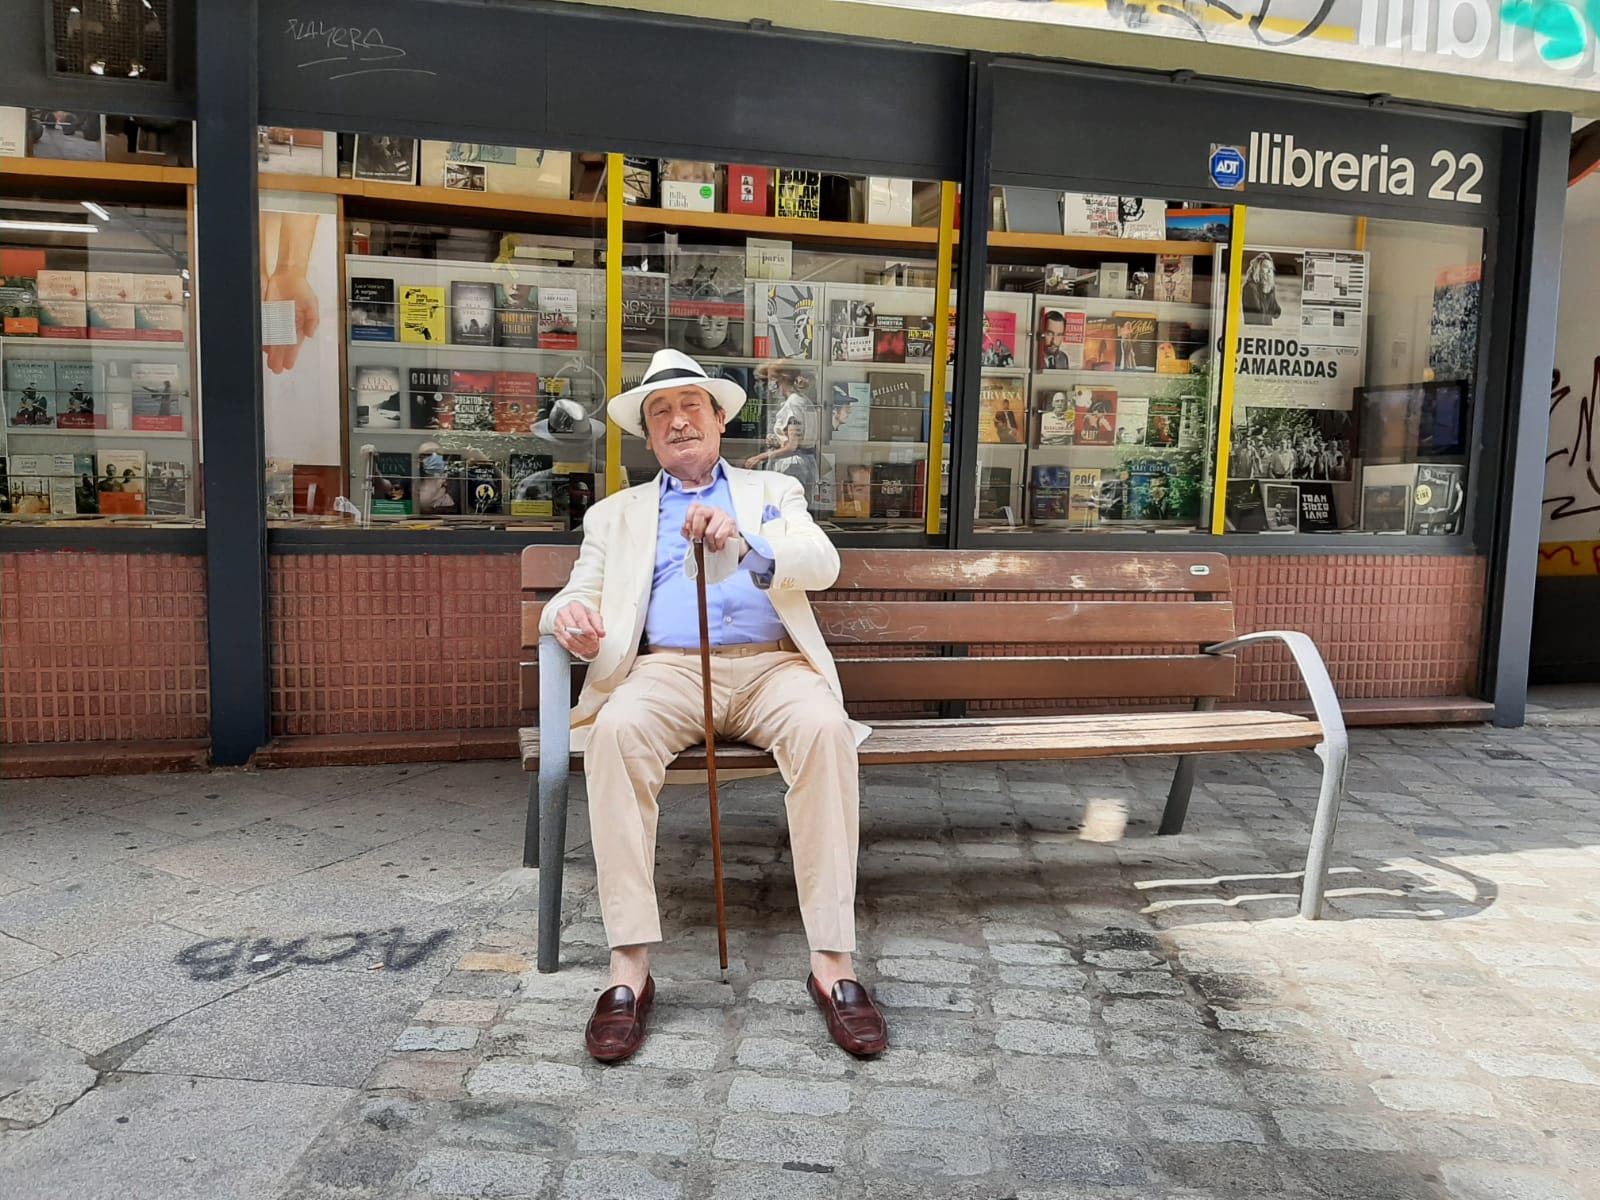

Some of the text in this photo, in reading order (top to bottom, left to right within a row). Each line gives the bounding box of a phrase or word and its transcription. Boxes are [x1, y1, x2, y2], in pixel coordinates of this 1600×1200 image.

[1359, 0, 1600, 74] llibre
[1215, 159, 1240, 175] ADT
[1248, 131, 1484, 204] llibreria 22
[778, 198, 819, 211] LETRAS
[777, 209, 819, 219] COMPLETAS
[762, 254, 785, 265] paris
[1233, 357, 1338, 379] AMARADAS
[872, 382, 909, 399] METALLICA
[981, 390, 1023, 400] IRVANA
